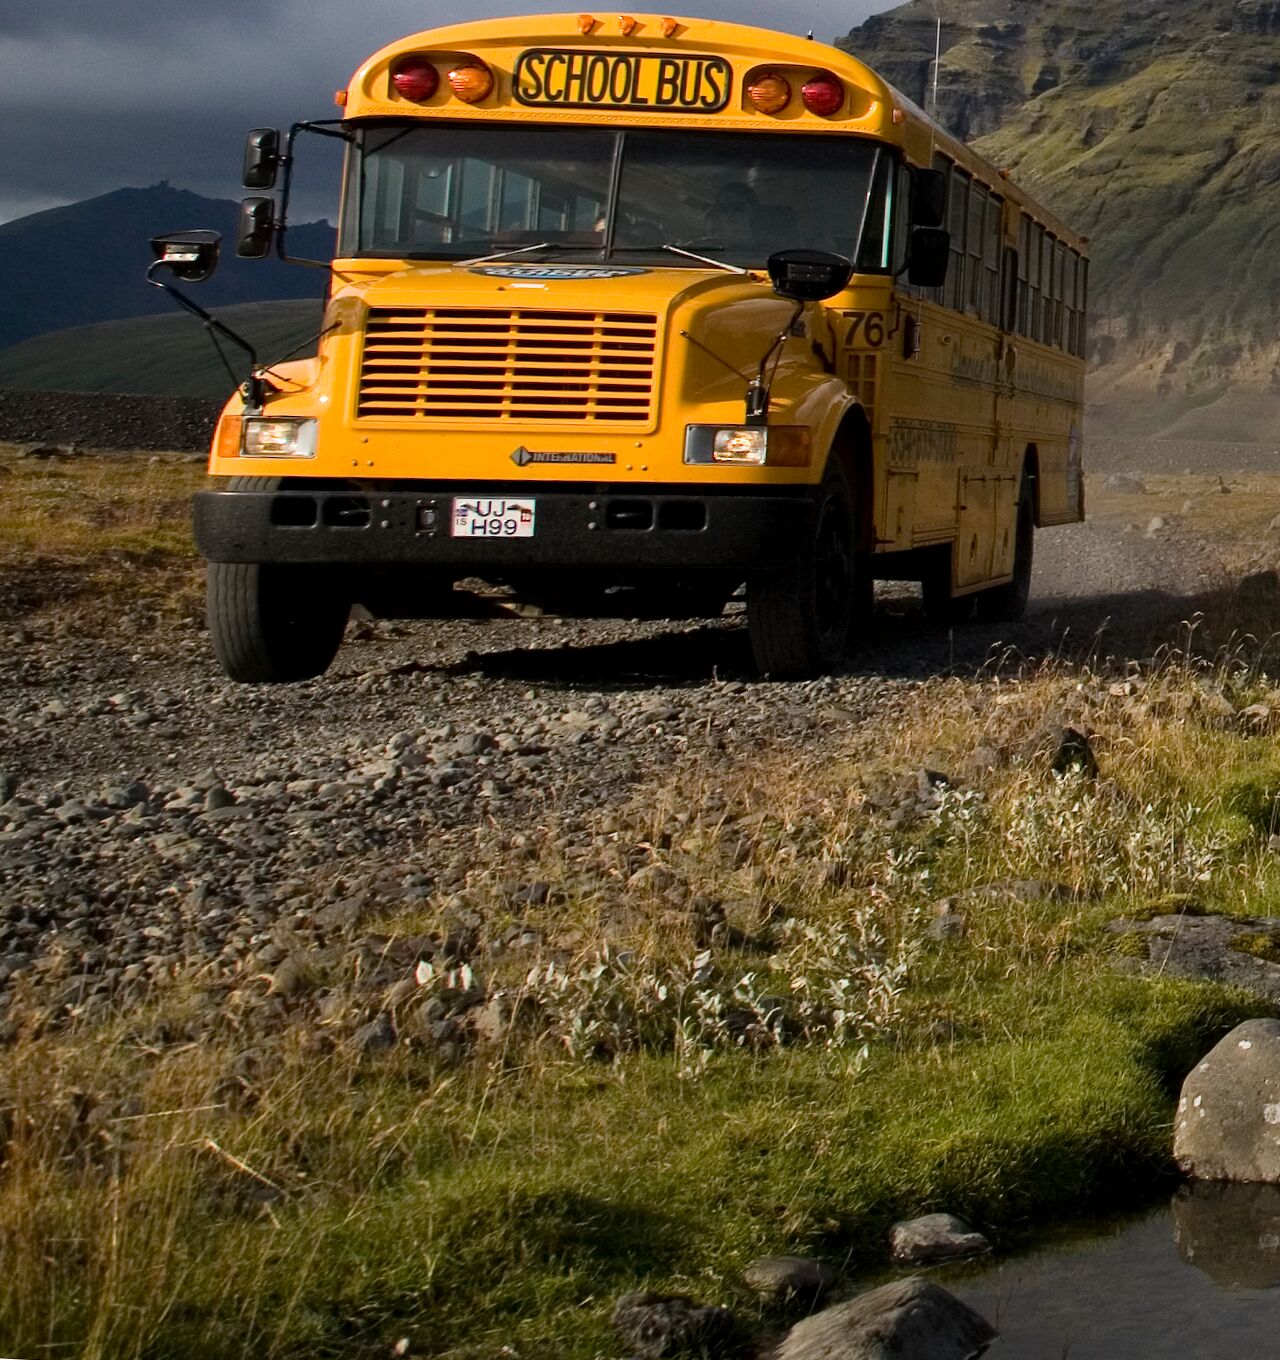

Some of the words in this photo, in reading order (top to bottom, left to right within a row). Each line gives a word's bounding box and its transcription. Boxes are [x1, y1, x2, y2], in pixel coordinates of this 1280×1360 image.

[521, 53, 649, 105] SCHOOL
[655, 58, 724, 108] BUS
[842, 311, 884, 347] 76
[532, 452, 614, 463] INTERNATIONAL
[476, 500, 506, 517] UJ
[471, 518, 518, 535] H99
